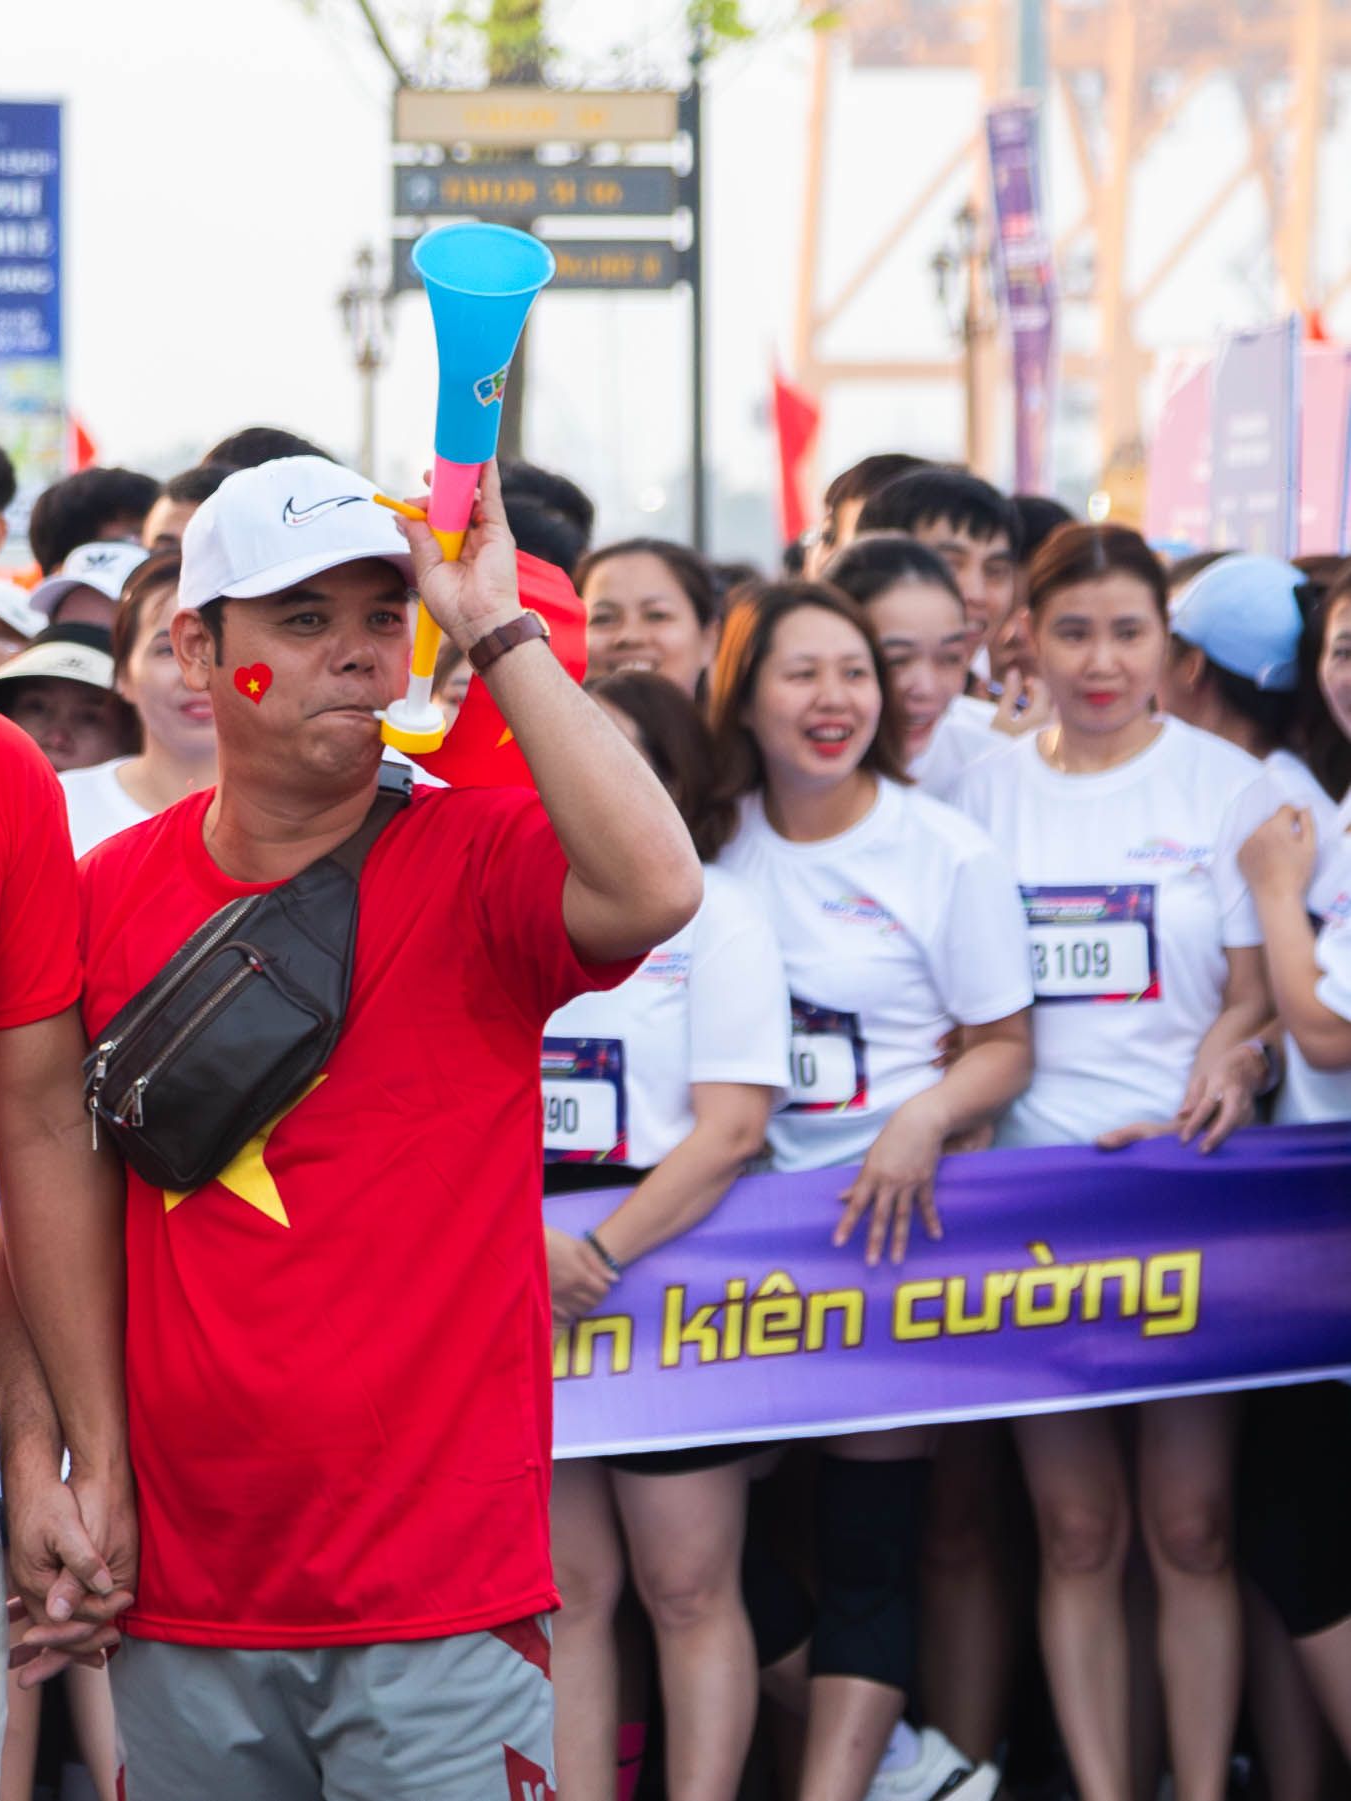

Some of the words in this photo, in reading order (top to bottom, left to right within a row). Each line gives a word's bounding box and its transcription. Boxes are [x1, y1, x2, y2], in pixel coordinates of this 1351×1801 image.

[1033, 942, 1110, 980] 3109
[790, 1052, 817, 1088] 0
[543, 1096, 580, 1134] 90
[661, 1269, 865, 1369] kiên
[893, 1240, 1203, 1342] cường
